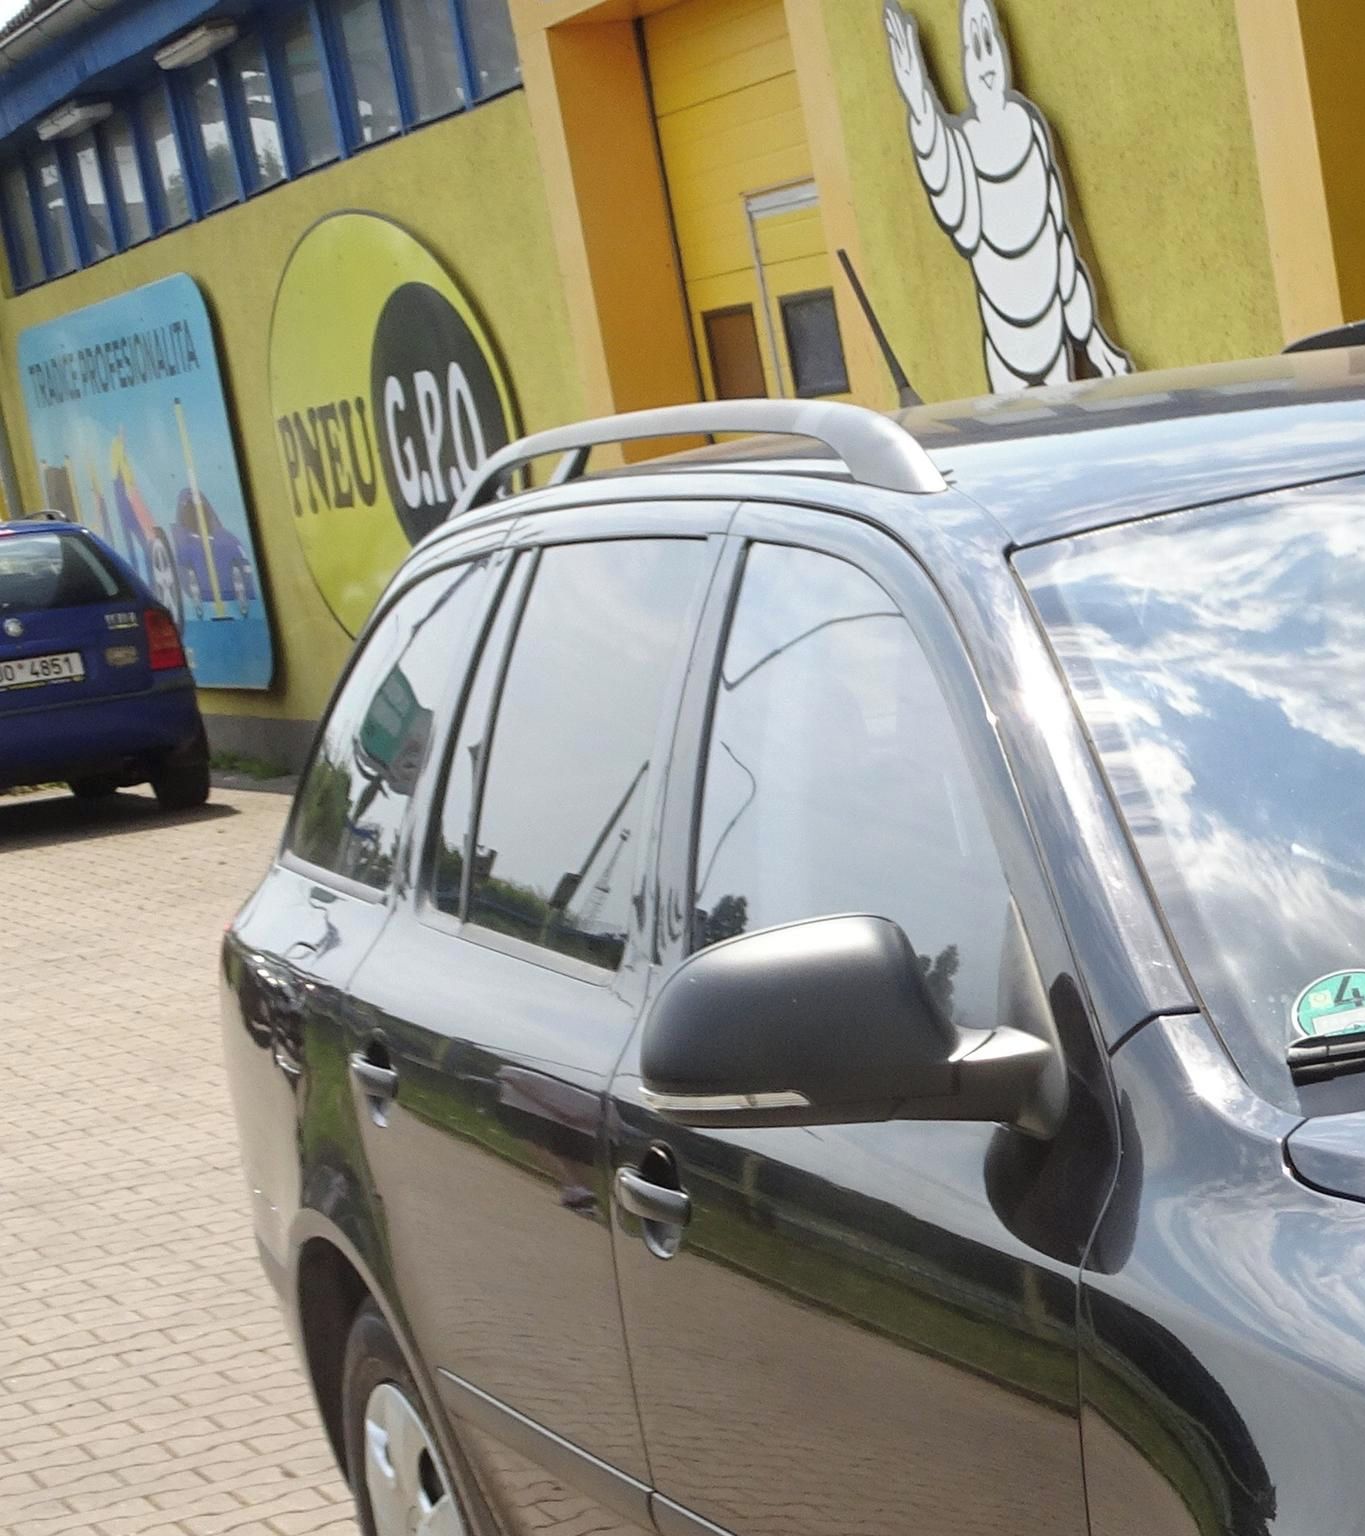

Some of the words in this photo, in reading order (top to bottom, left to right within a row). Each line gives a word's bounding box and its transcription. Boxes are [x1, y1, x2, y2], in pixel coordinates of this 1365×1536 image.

[277, 396, 377, 518] PNEU
[30, 656, 73, 677] 4851
[1333, 975, 1365, 1007] 4
